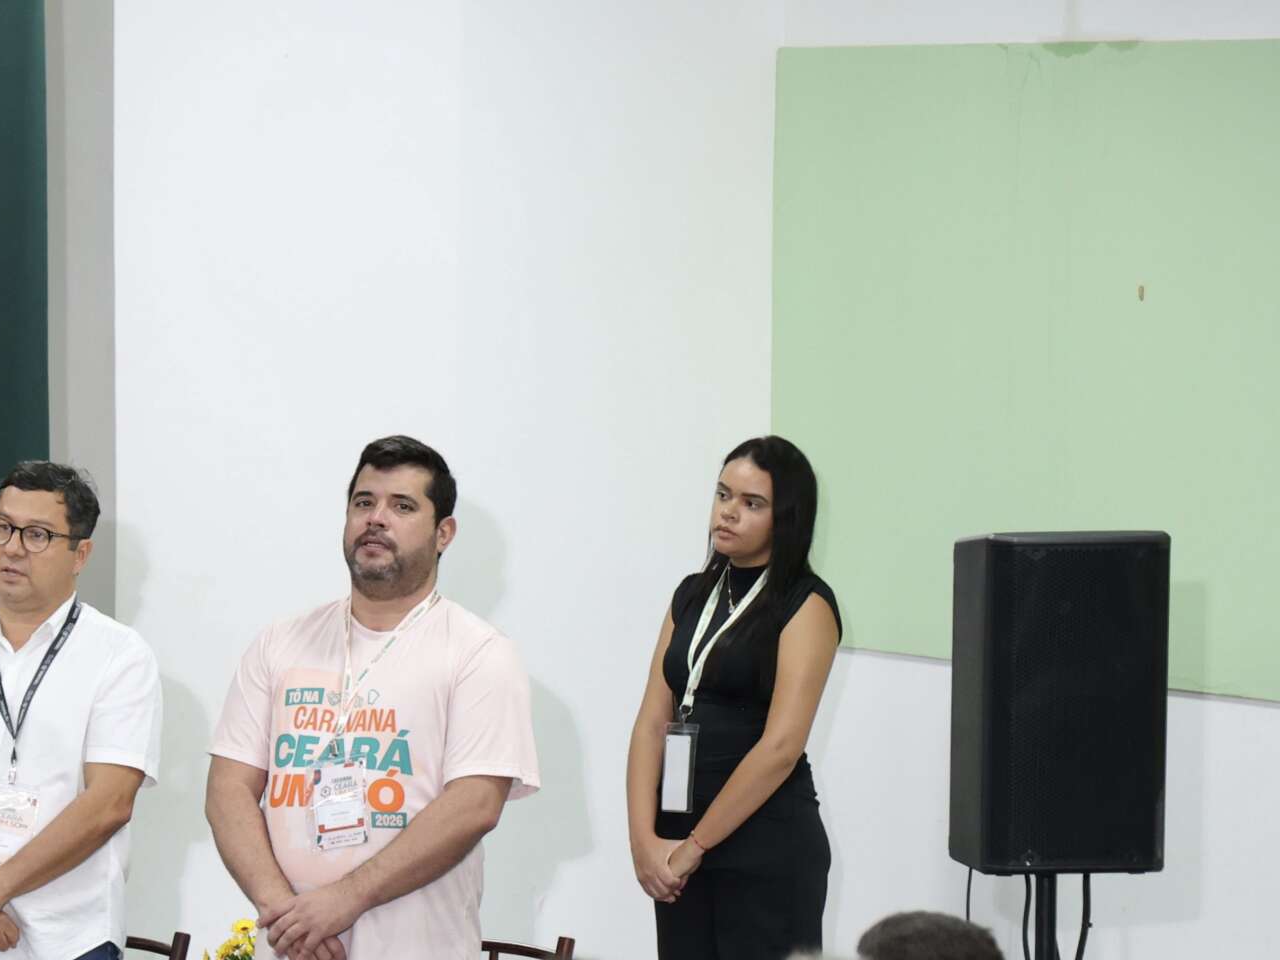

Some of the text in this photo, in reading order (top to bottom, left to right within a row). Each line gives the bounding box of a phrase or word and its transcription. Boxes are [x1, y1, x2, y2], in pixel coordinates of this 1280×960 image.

[303, 690, 320, 703] NA
[274, 729, 413, 776] CEARÁ
[363, 769, 405, 813] Ó
[375, 812, 404, 827] 2026
